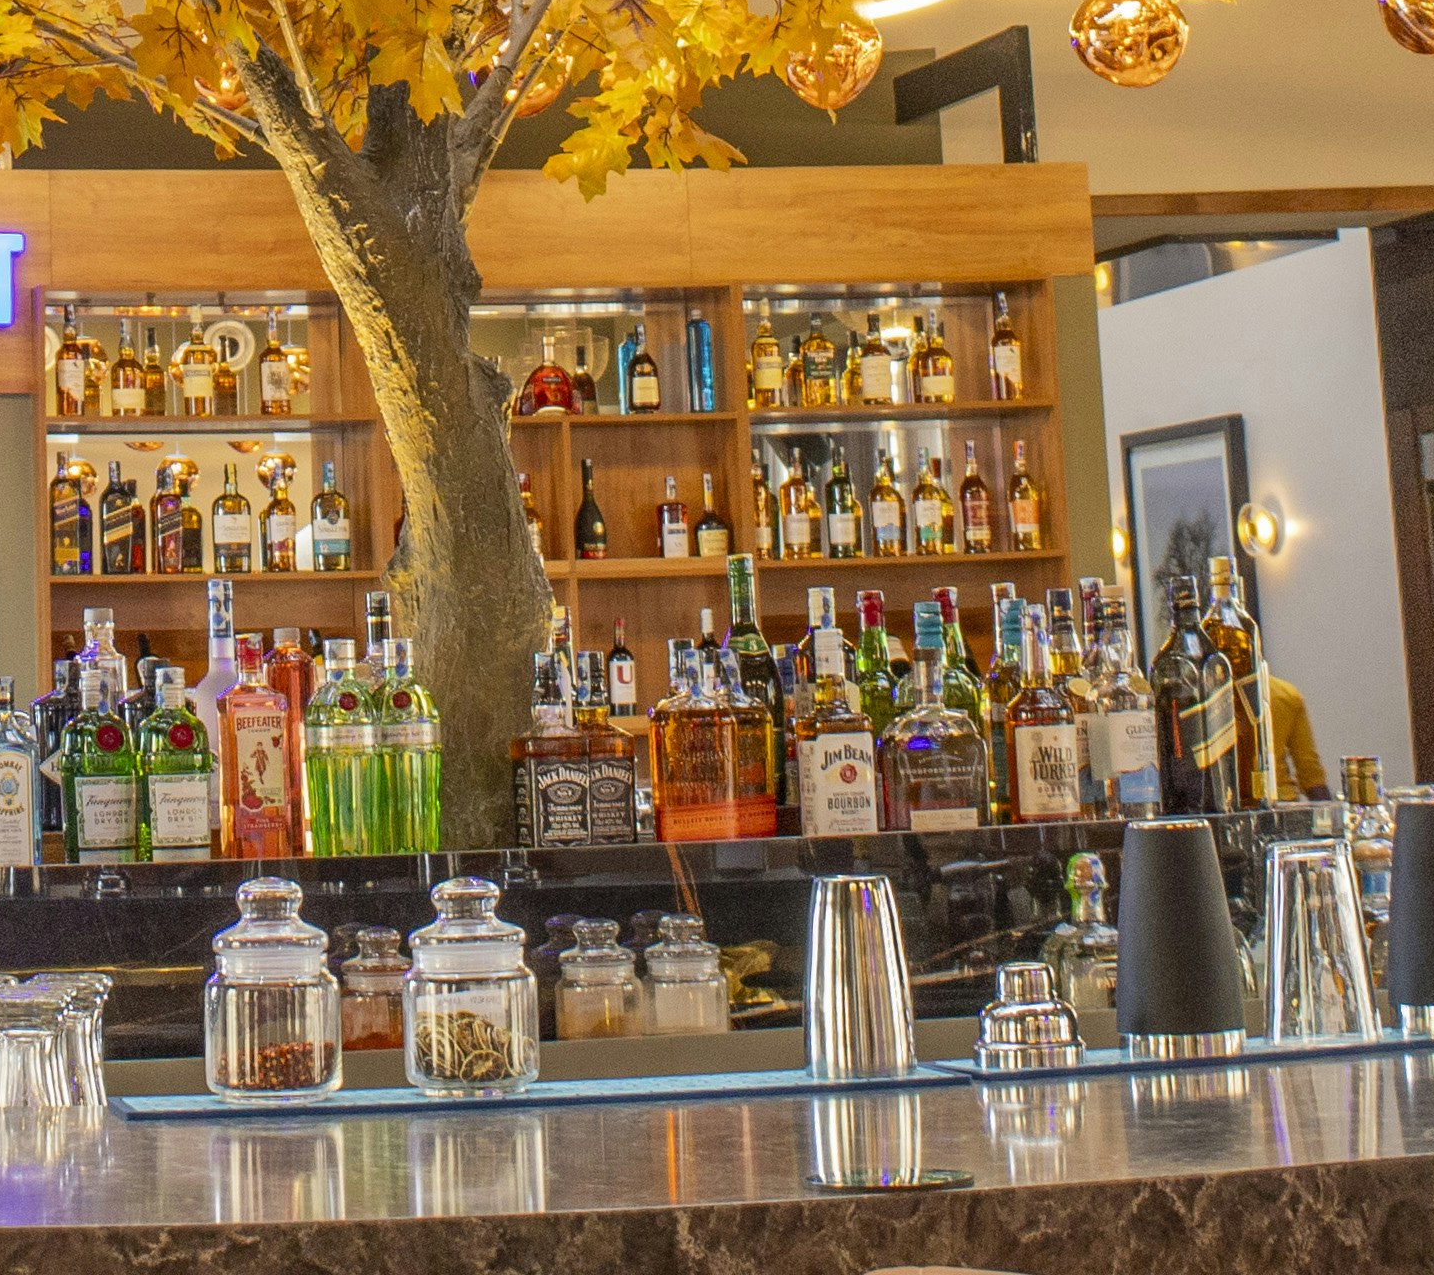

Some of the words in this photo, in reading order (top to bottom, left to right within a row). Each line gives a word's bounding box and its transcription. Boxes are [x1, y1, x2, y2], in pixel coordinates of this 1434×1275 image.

[236, 715, 282, 732] BEEFEATER
[820, 748, 844, 770] JIM
[843, 744, 872, 764] BEAM
[1037, 746, 1073, 764] WILD
[1031, 762, 1077, 781] TURKEY
[826, 795, 871, 810] BOURBON
